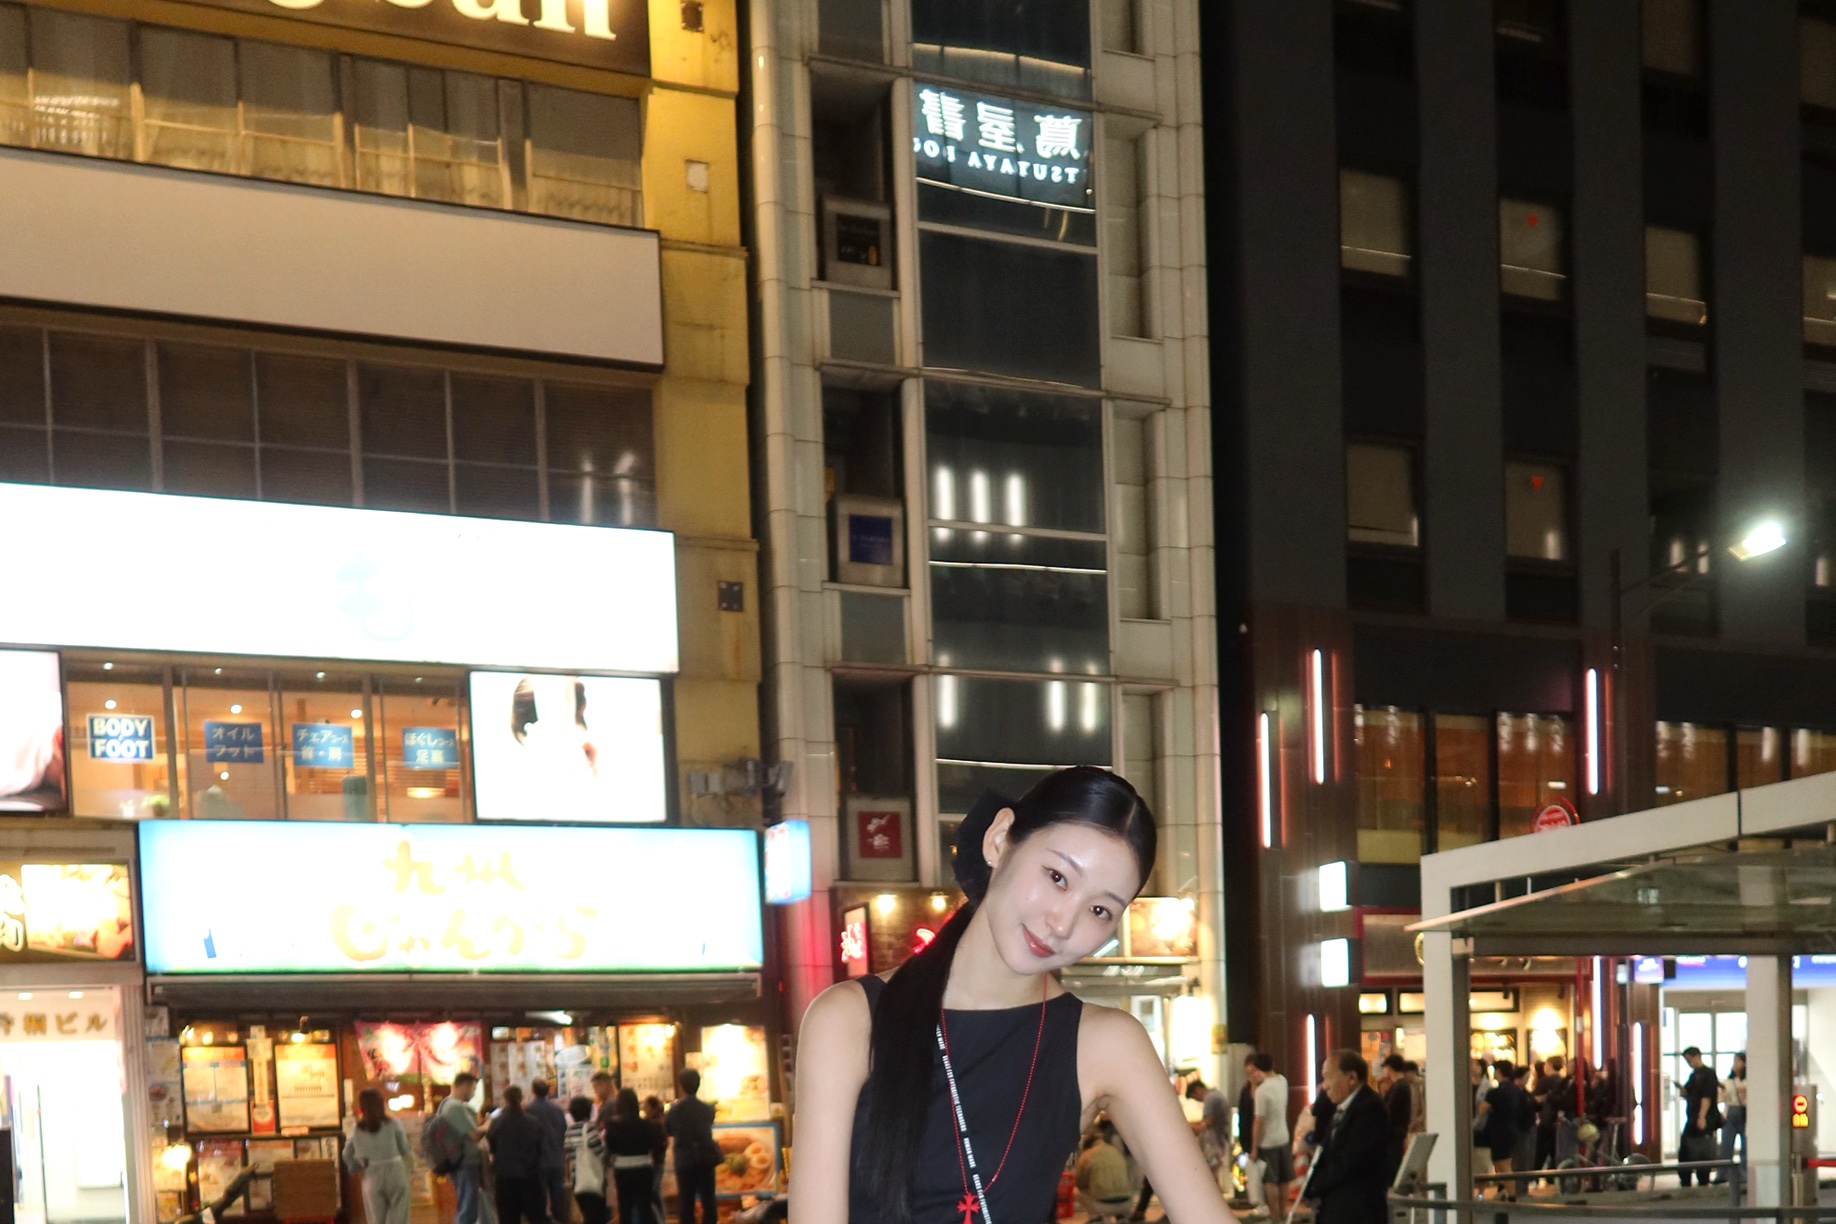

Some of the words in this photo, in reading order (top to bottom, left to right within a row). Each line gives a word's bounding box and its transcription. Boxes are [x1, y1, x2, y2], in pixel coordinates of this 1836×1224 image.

[93, 717, 148, 738] BODY
[212, 726, 255, 741] オイル
[95, 738, 150, 758] FOOT
[382, 840, 527, 895] 九州
